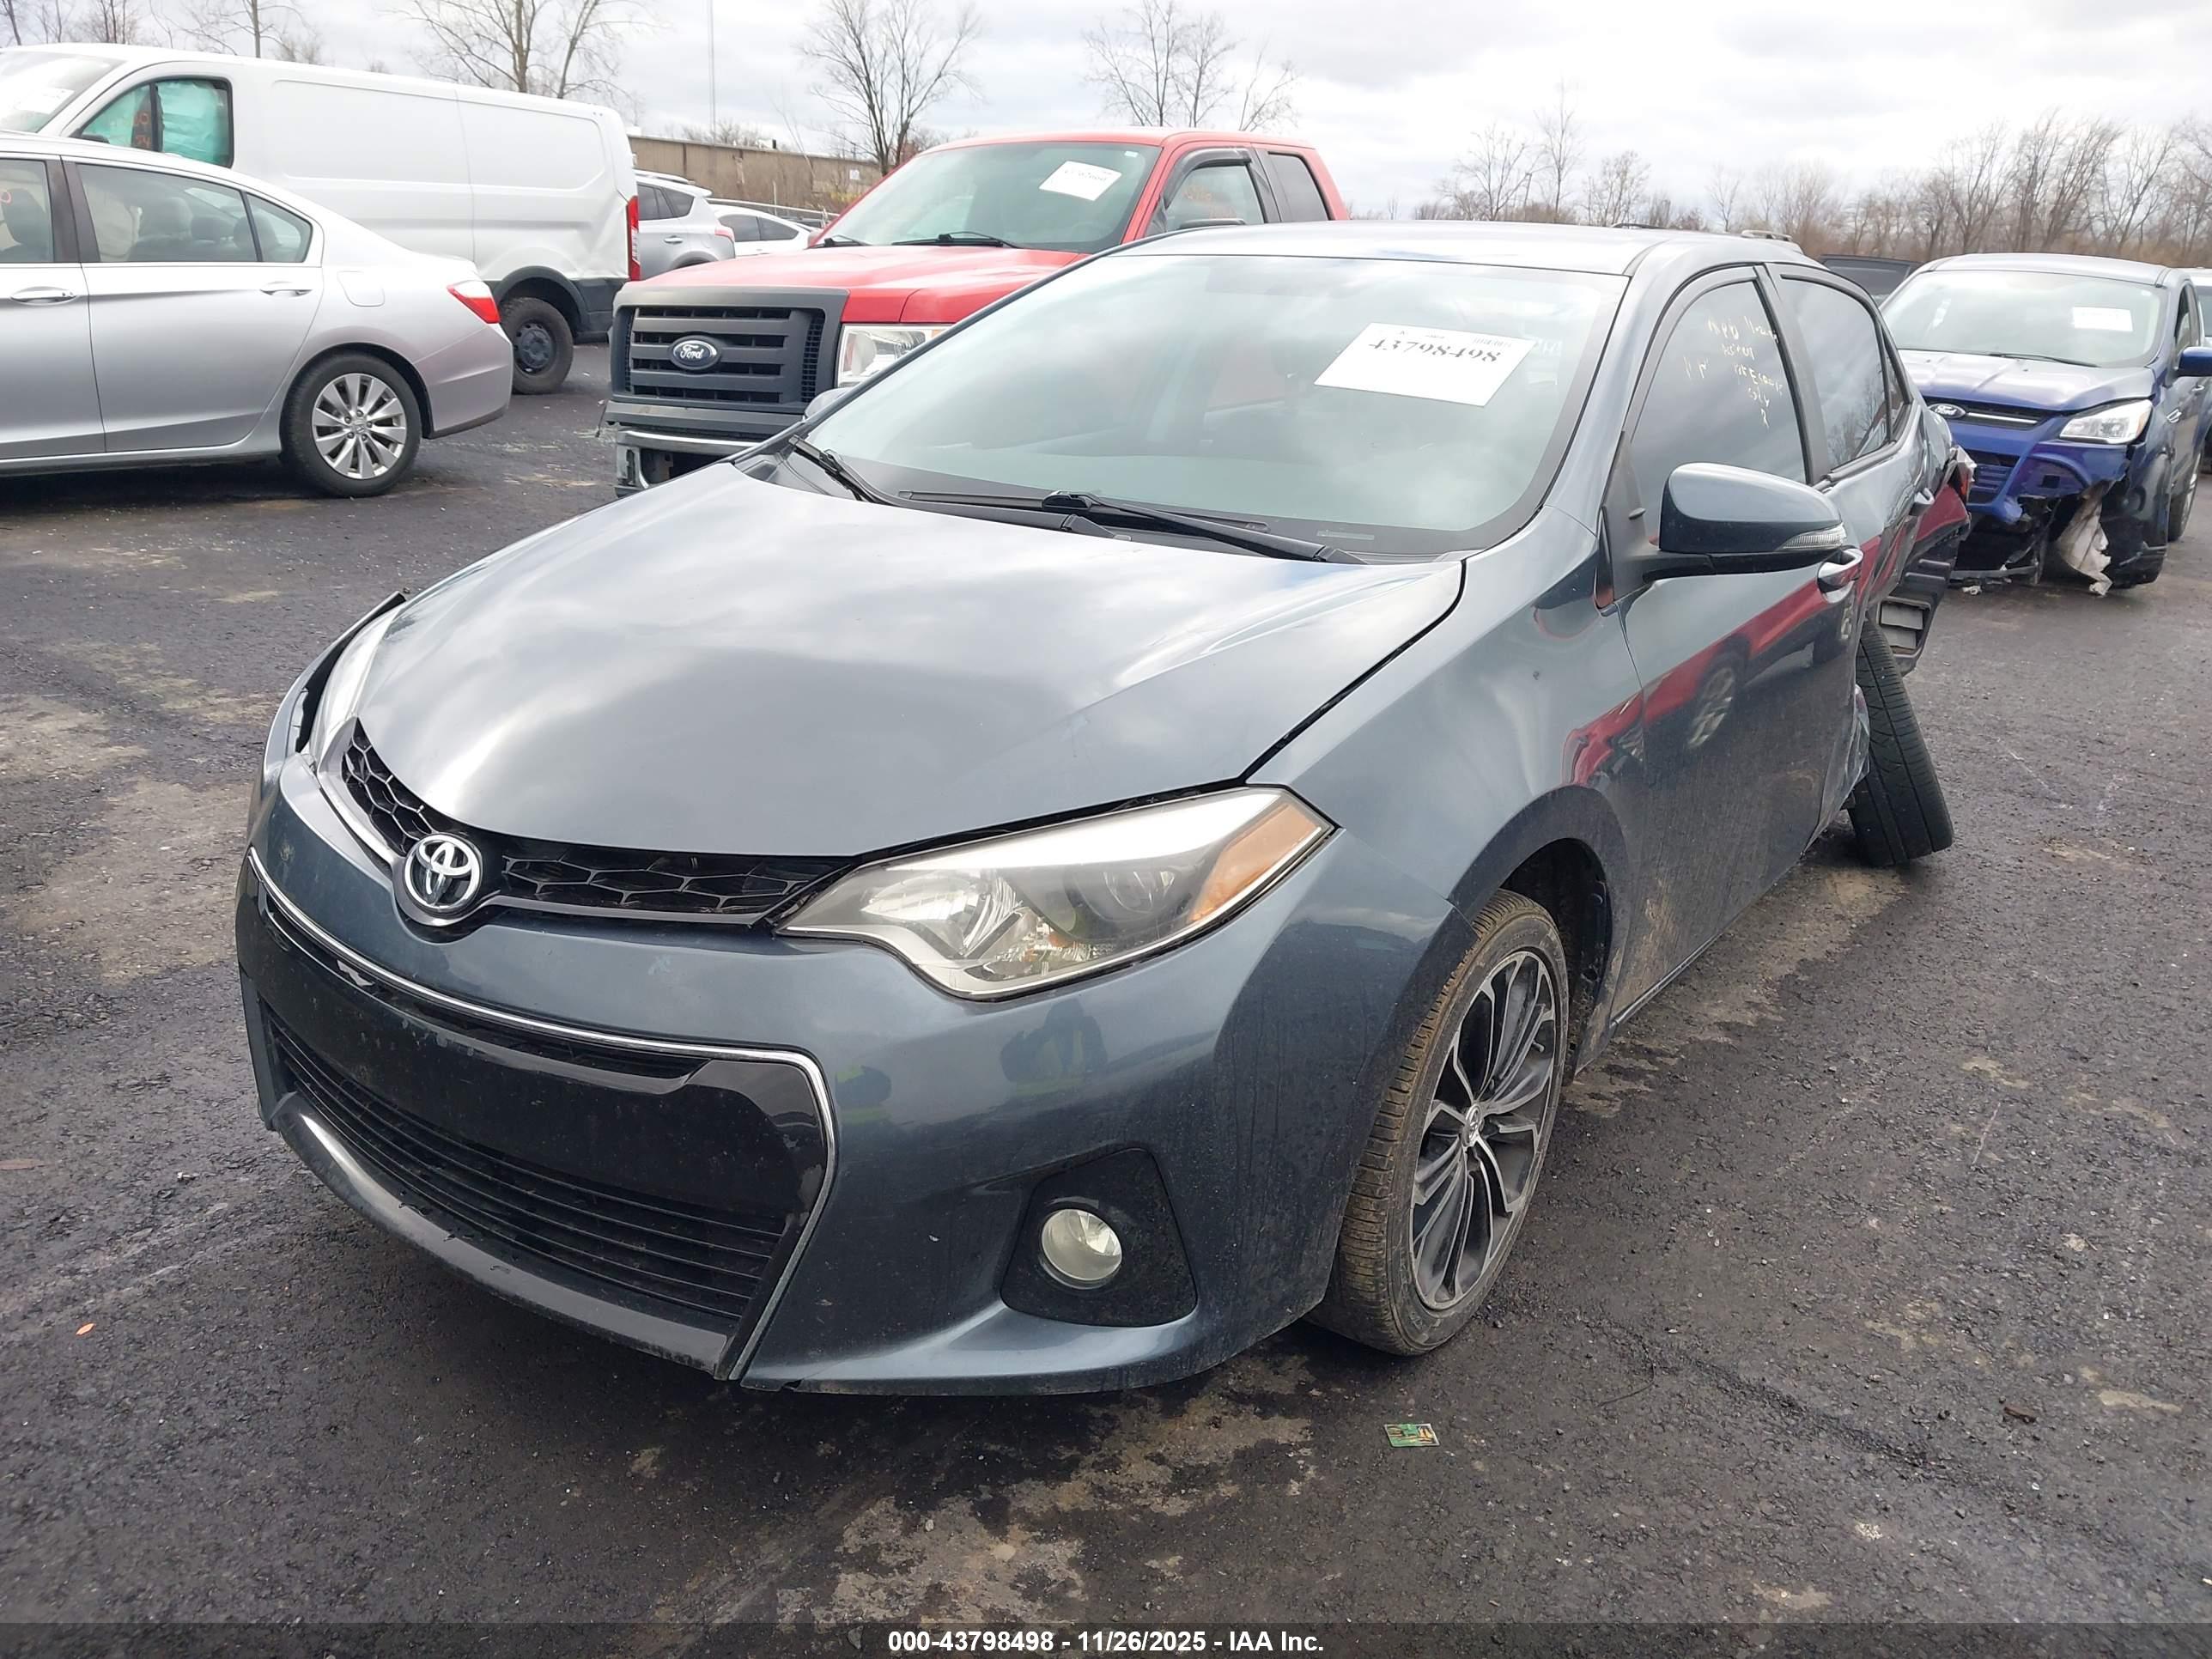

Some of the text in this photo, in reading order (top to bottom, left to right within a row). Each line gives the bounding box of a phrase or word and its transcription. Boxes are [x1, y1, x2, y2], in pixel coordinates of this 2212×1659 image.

[679, 343, 705, 359] Ford
[1368, 338, 1502, 363] 43798498
[1934, 404, 1958, 416] Ford
